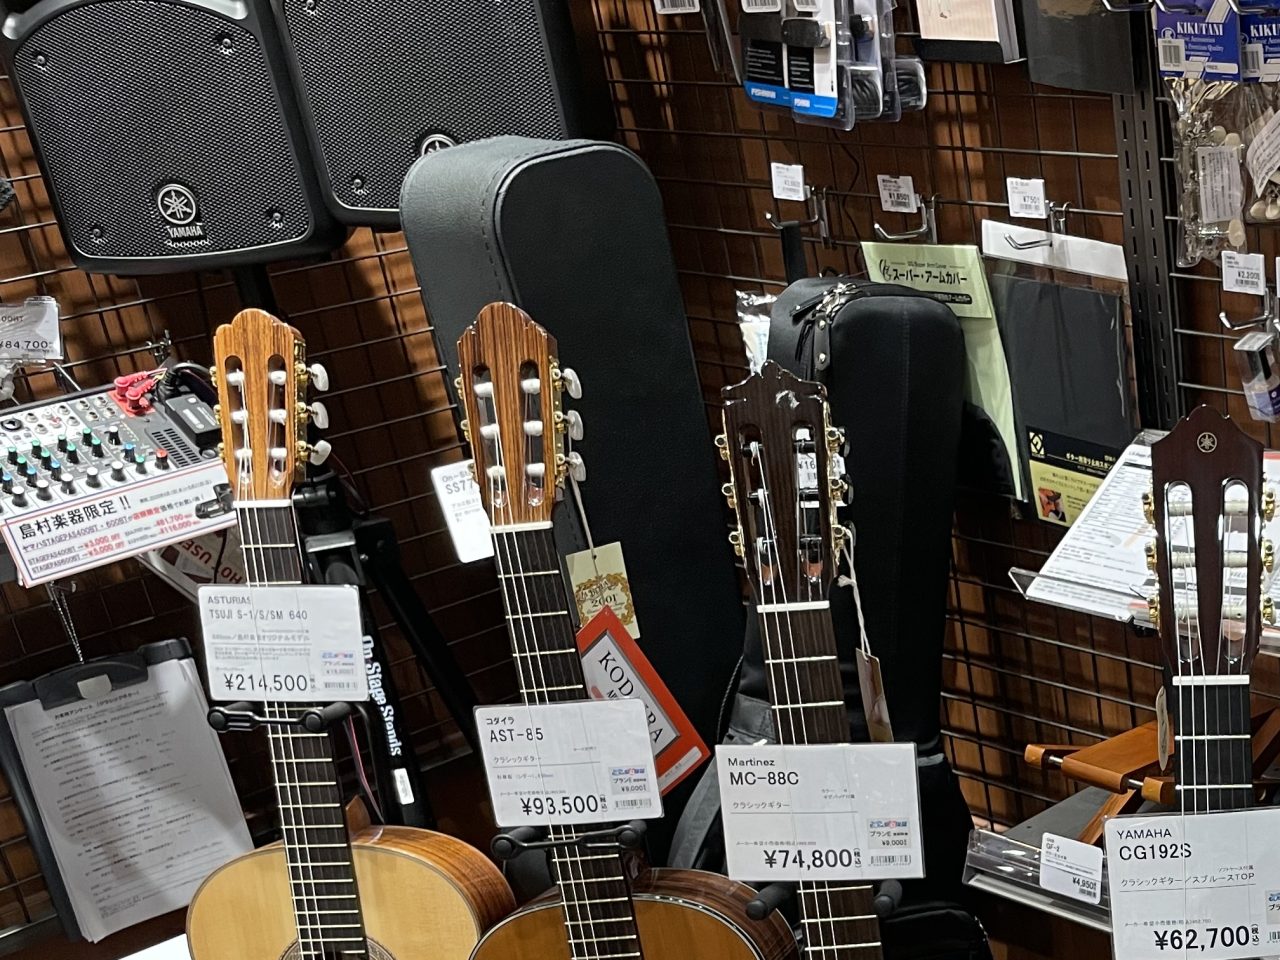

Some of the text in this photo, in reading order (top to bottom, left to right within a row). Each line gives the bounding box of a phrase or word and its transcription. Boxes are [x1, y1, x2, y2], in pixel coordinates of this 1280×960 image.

[1176, 21, 1224, 36] KIKUTANI
[166, 225, 203, 238] YAMAHA
[892, 268, 969, 286] スーパー・アームカバー
[18, 500, 118, 540] 島村楽器限定
[207, 596, 251, 605] ASTURIAS
[209, 609, 308, 621] TSUJI S-1/S/SM 640
[224, 673, 308, 693] ¥214,500
[485, 716, 516, 727] コダイラ
[489, 728, 545, 744] AST-85
[727, 757, 776, 767] Martinez
[730, 771, 800, 787] MC-88C
[520, 794, 599, 817] ¥93,500
[732, 801, 791, 810] クラシックギター
[1116, 827, 1172, 840] YAMAHA
[763, 848, 851, 871] ¥74,800
[1118, 843, 1193, 861] CG192S
[1153, 925, 1250, 952] ¥62,700
